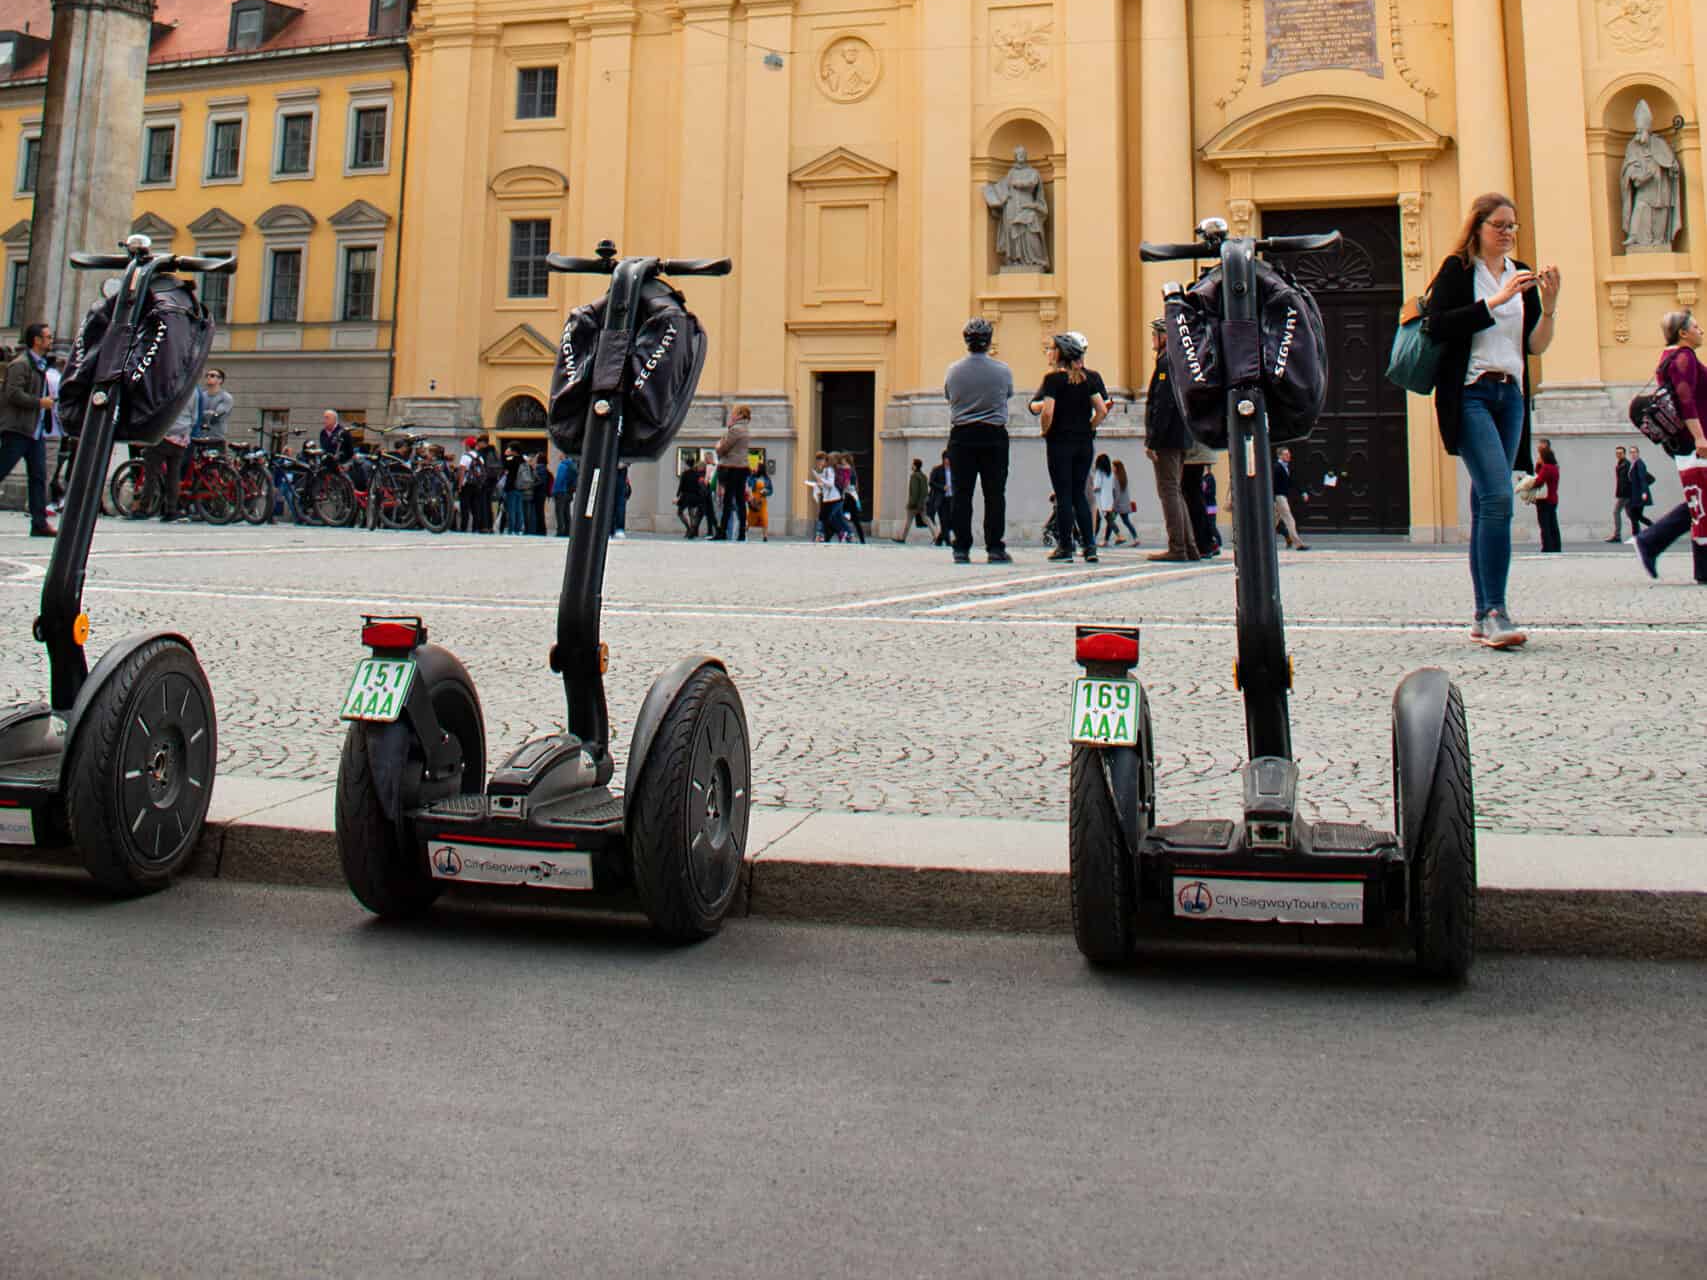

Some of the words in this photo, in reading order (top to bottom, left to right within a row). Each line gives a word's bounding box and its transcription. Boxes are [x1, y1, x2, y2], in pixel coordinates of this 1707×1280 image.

[132, 321, 167, 382] SEGWAY
[1176, 313, 1206, 383] SEGWAY
[1274, 306, 1297, 379] SEGWAY
[634, 324, 677, 389] SEGWAY
[363, 663, 405, 688] 151
[349, 691, 393, 716] AAA
[1083, 683, 1130, 710] 169
[1079, 712, 1128, 739] AAA
[1215, 895, 1360, 911] CitySegwayTours.com
